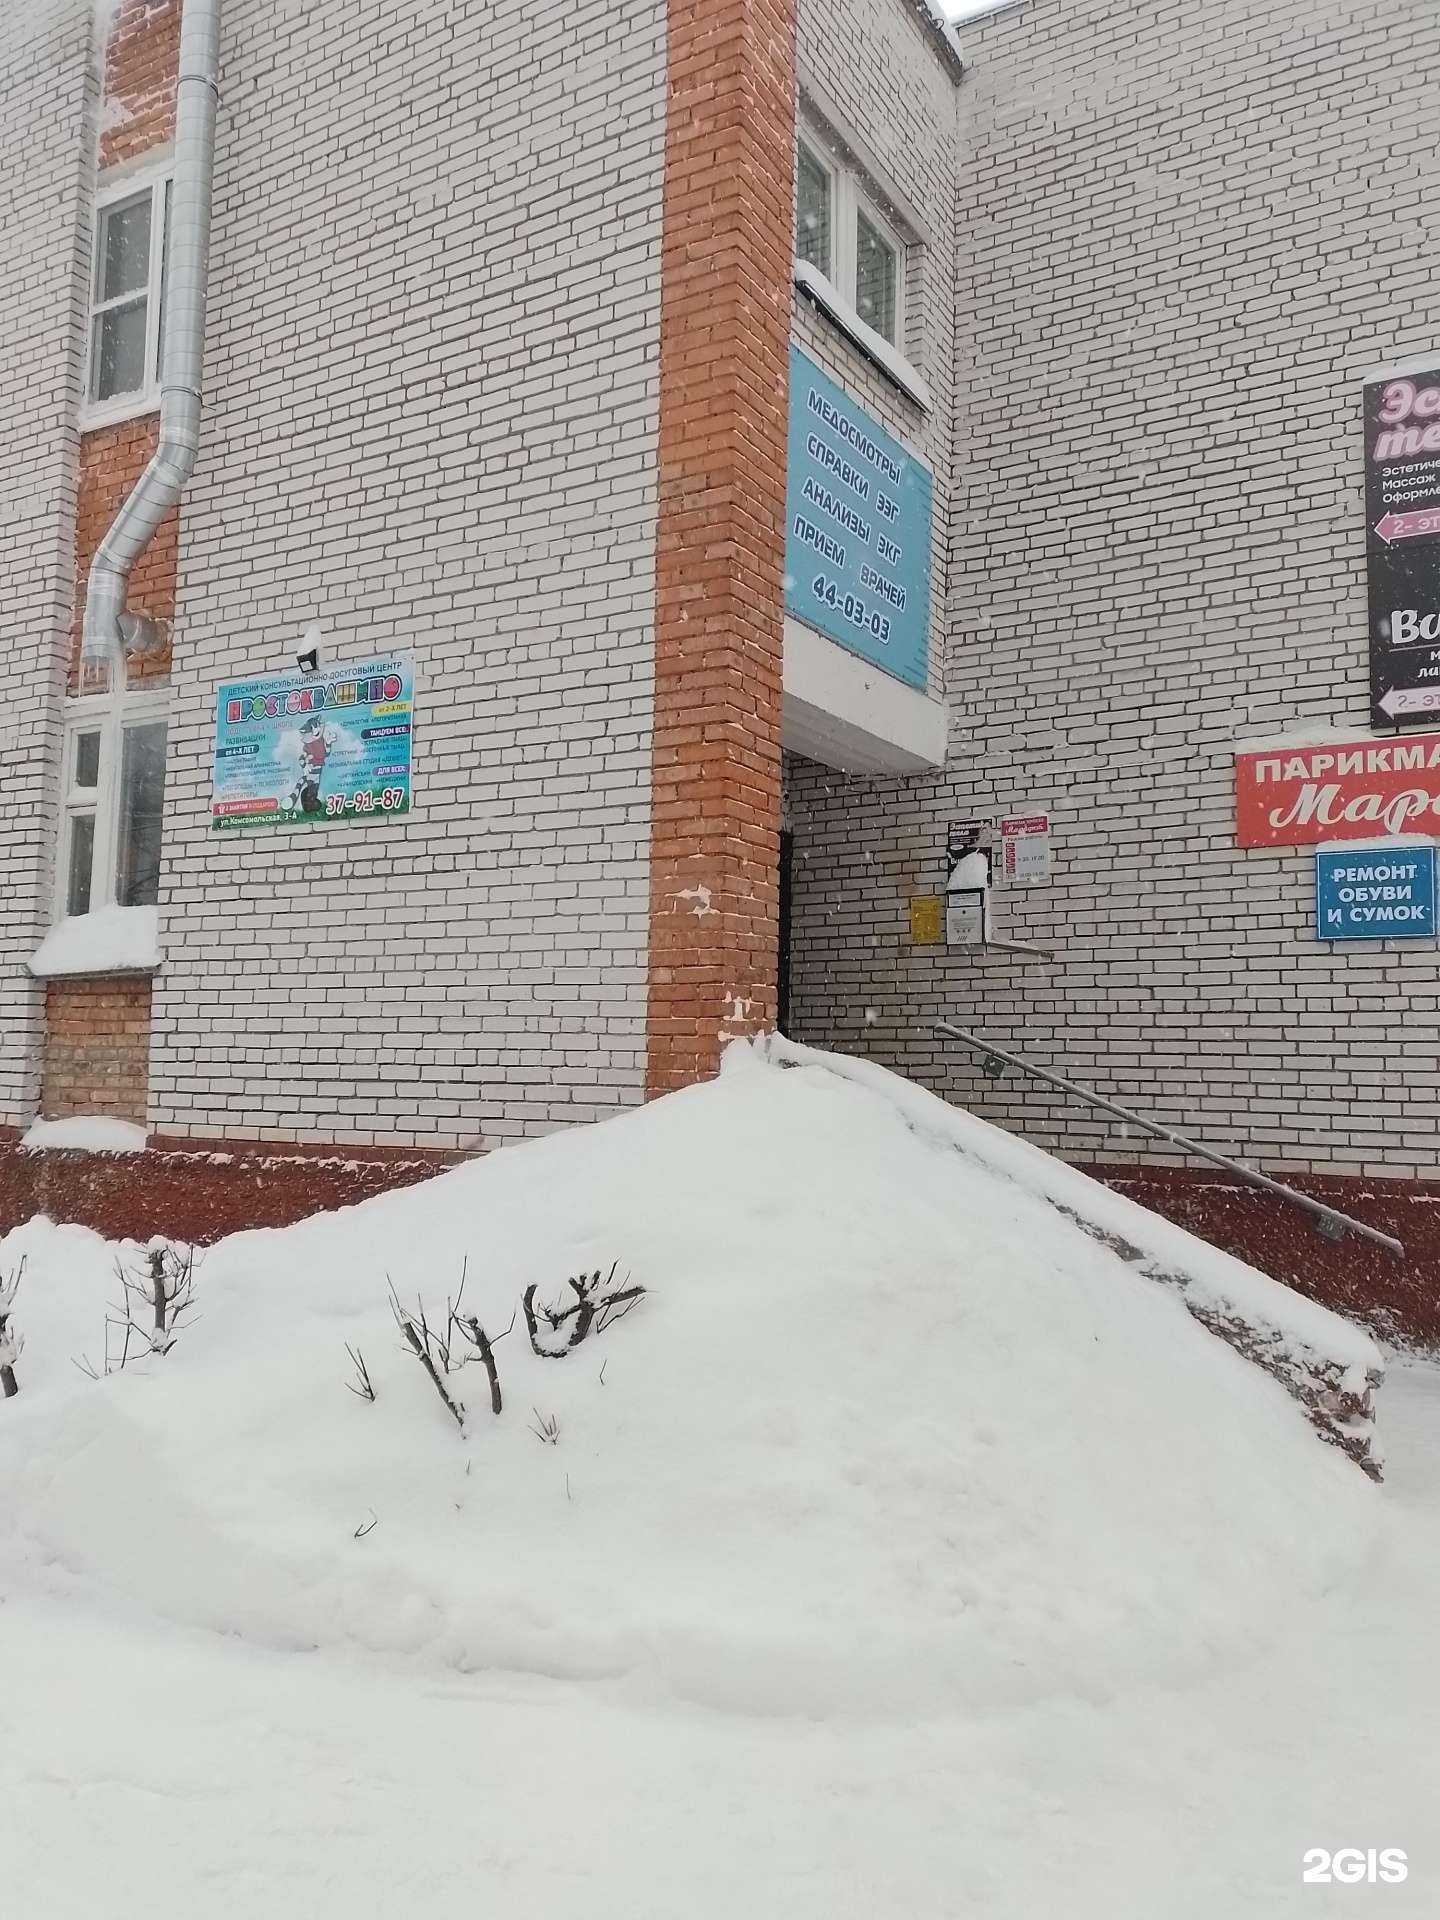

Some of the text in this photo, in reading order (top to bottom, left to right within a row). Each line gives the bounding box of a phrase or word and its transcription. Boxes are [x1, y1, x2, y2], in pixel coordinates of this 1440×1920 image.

[808, 387, 901, 486] МЕДОСМОТРЫ
[807, 432, 900, 522] СПРАВКИ ЭЭГ
[1382, 474, 1436, 490] Массаж
[802, 477, 901, 565] АНАЛИЗЫ ЭКГ
[794, 513, 907, 612] ПРИЕМ ВРАЧЕЙ
[813, 572, 890, 644] 44-03-03
[227, 683, 259, 697] ДЕТСКИЙ
[376, 661, 402, 674] ЦЕНТР
[227, 675, 403, 723] ПРОСТОКВАШИНО
[396, 703, 407, 711] ЛЕТ
[370, 728, 394, 737] ТАНЦУЕМ
[243, 746, 254, 754] ЛЕТ
[377, 767, 391, 776] ДЛЯ
[326, 787, 404, 816] 37-91-87
[1333, 864, 1418, 882] РЕМОНТ
[1338, 885, 1411, 902] ОБУВИ
[1327, 906, 1425, 924] И СУМОК
